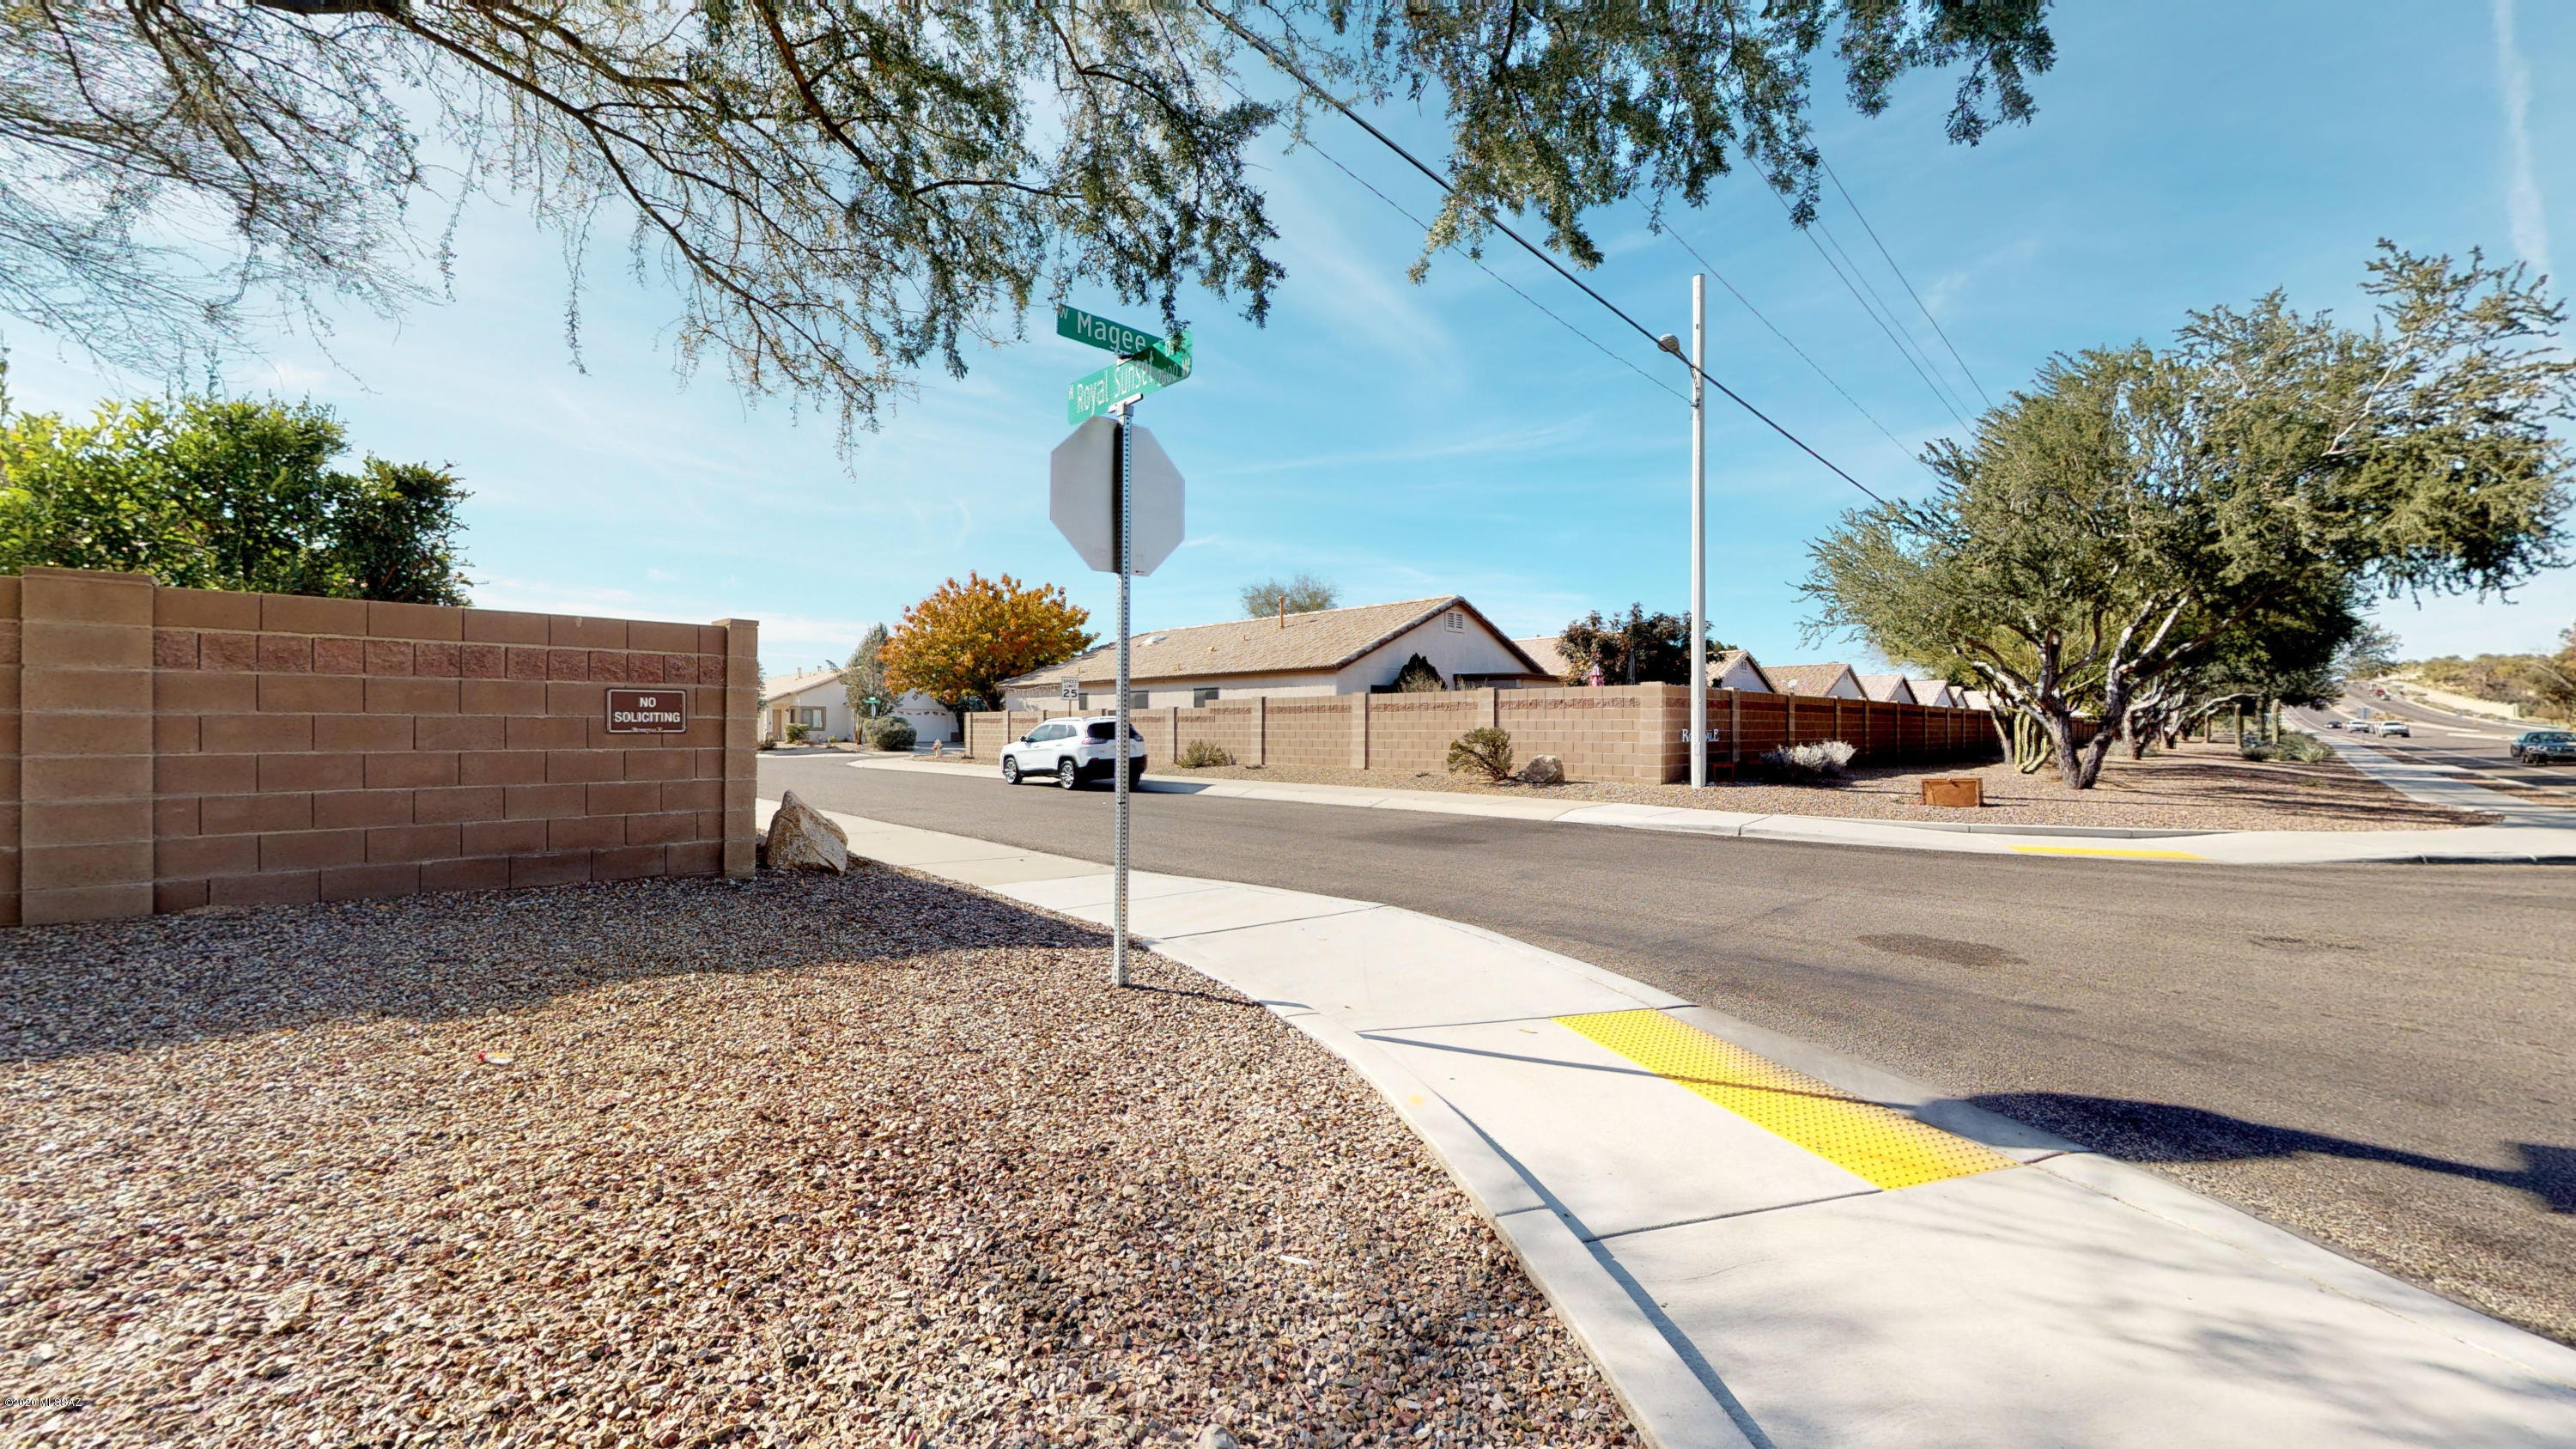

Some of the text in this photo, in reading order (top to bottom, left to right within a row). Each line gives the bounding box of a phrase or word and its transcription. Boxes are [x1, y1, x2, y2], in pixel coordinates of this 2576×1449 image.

[1077, 311, 1146, 351] Magee
[1077, 369, 1109, 417] Royal
[1115, 350, 1154, 398] Sunset
[1063, 689, 1078, 697] 25
[639, 697, 657, 708] NO
[614, 711, 681, 722] SOLICITING
